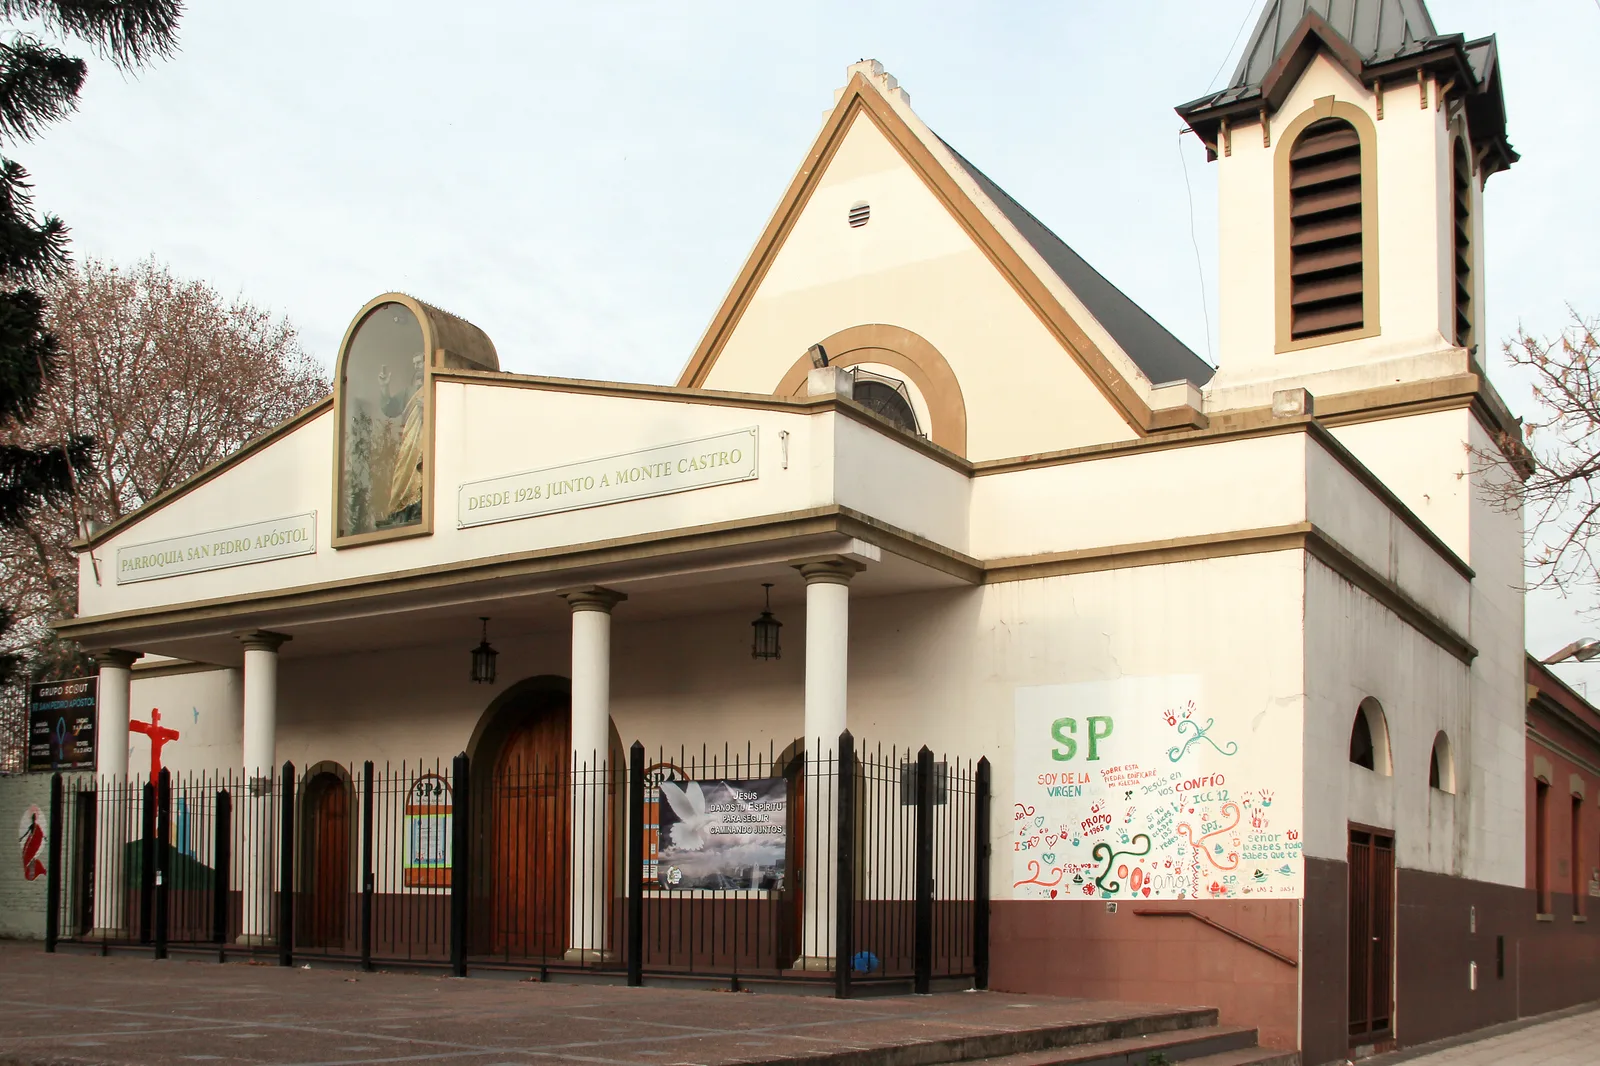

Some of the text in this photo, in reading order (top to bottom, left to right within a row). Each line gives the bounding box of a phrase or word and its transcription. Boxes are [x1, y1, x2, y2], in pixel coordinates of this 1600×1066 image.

[468, 448, 743, 511] DESDE 1928 JUNTO A MONTE CASTRO
[121, 528, 309, 572] PARROQUIA SAN PEDRO APÓSTOL
[40, 683, 89, 697] GRUPO SCOUT
[1051, 716, 1114, 761] SP
[1100, 765, 1122, 777] SOBRE
[1037, 772, 1091, 785] SOY DE LA
[1118, 779, 1141, 787] IGLESIA
[1175, 772, 1225, 793] CONFÍO
[1047, 785, 1082, 797] VIRGEN
[736, 803, 746, 812] TU
[722, 814, 770, 823] PARA SEGUIR
[1080, 814, 1112, 831] PROMO
[710, 825, 783, 835] CAMINANDO JUNTOS
[1089, 824, 1105, 836] 1965
[1159, 834, 1179, 850] redes
[1251, 843, 1281, 851] sabes
[1242, 851, 1268, 860] sabes
[1287, 851, 1298, 859] te
[1153, 873, 1192, 890] años
